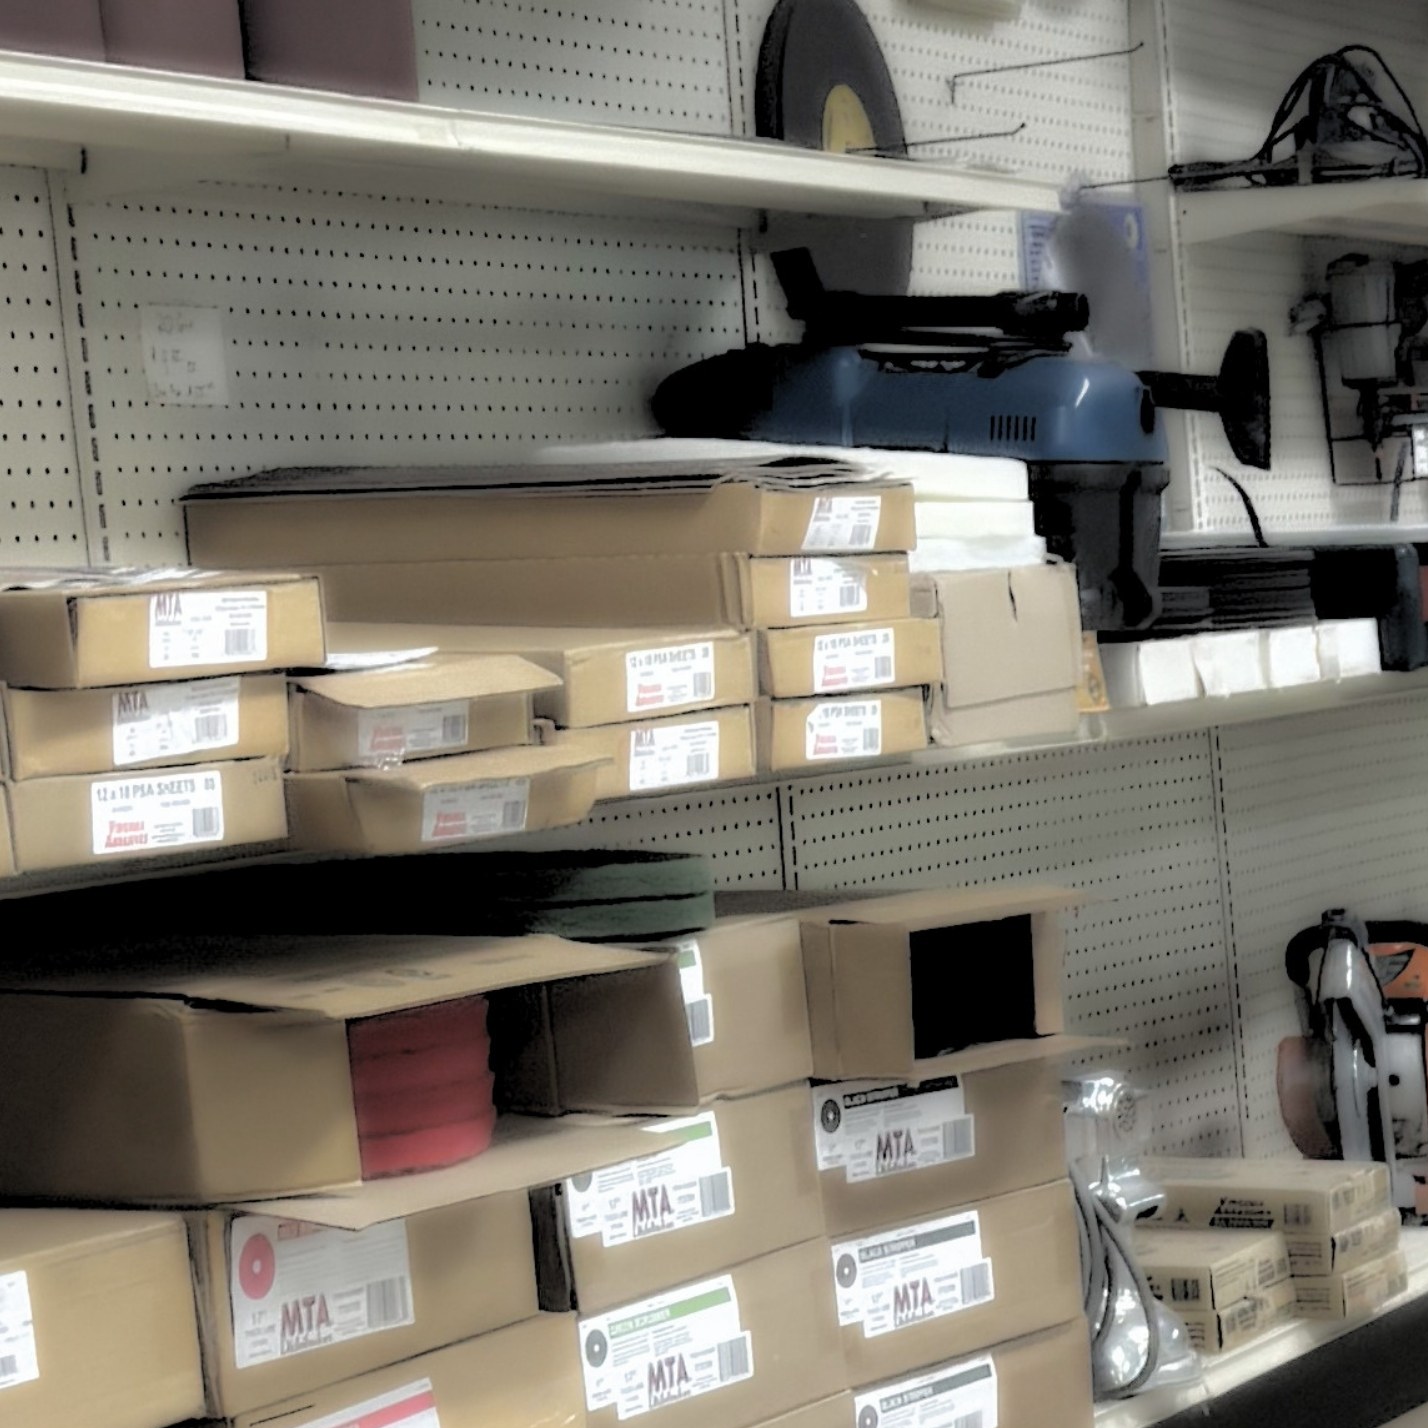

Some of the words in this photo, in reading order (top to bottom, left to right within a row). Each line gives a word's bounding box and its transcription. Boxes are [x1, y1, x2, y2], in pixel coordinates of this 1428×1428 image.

[154, 592, 183, 619] MTA
[117, 690, 149, 719] MTA
[132, 783, 154, 798] PSA
[157, 778, 196, 796] SHEETS
[876, 1127, 914, 1161] MTA
[632, 1184, 672, 1221] MTA
[894, 1276, 934, 1314] MTA
[282, 1293, 333, 1337] MTA
[649, 1353, 690, 1393] MTA
